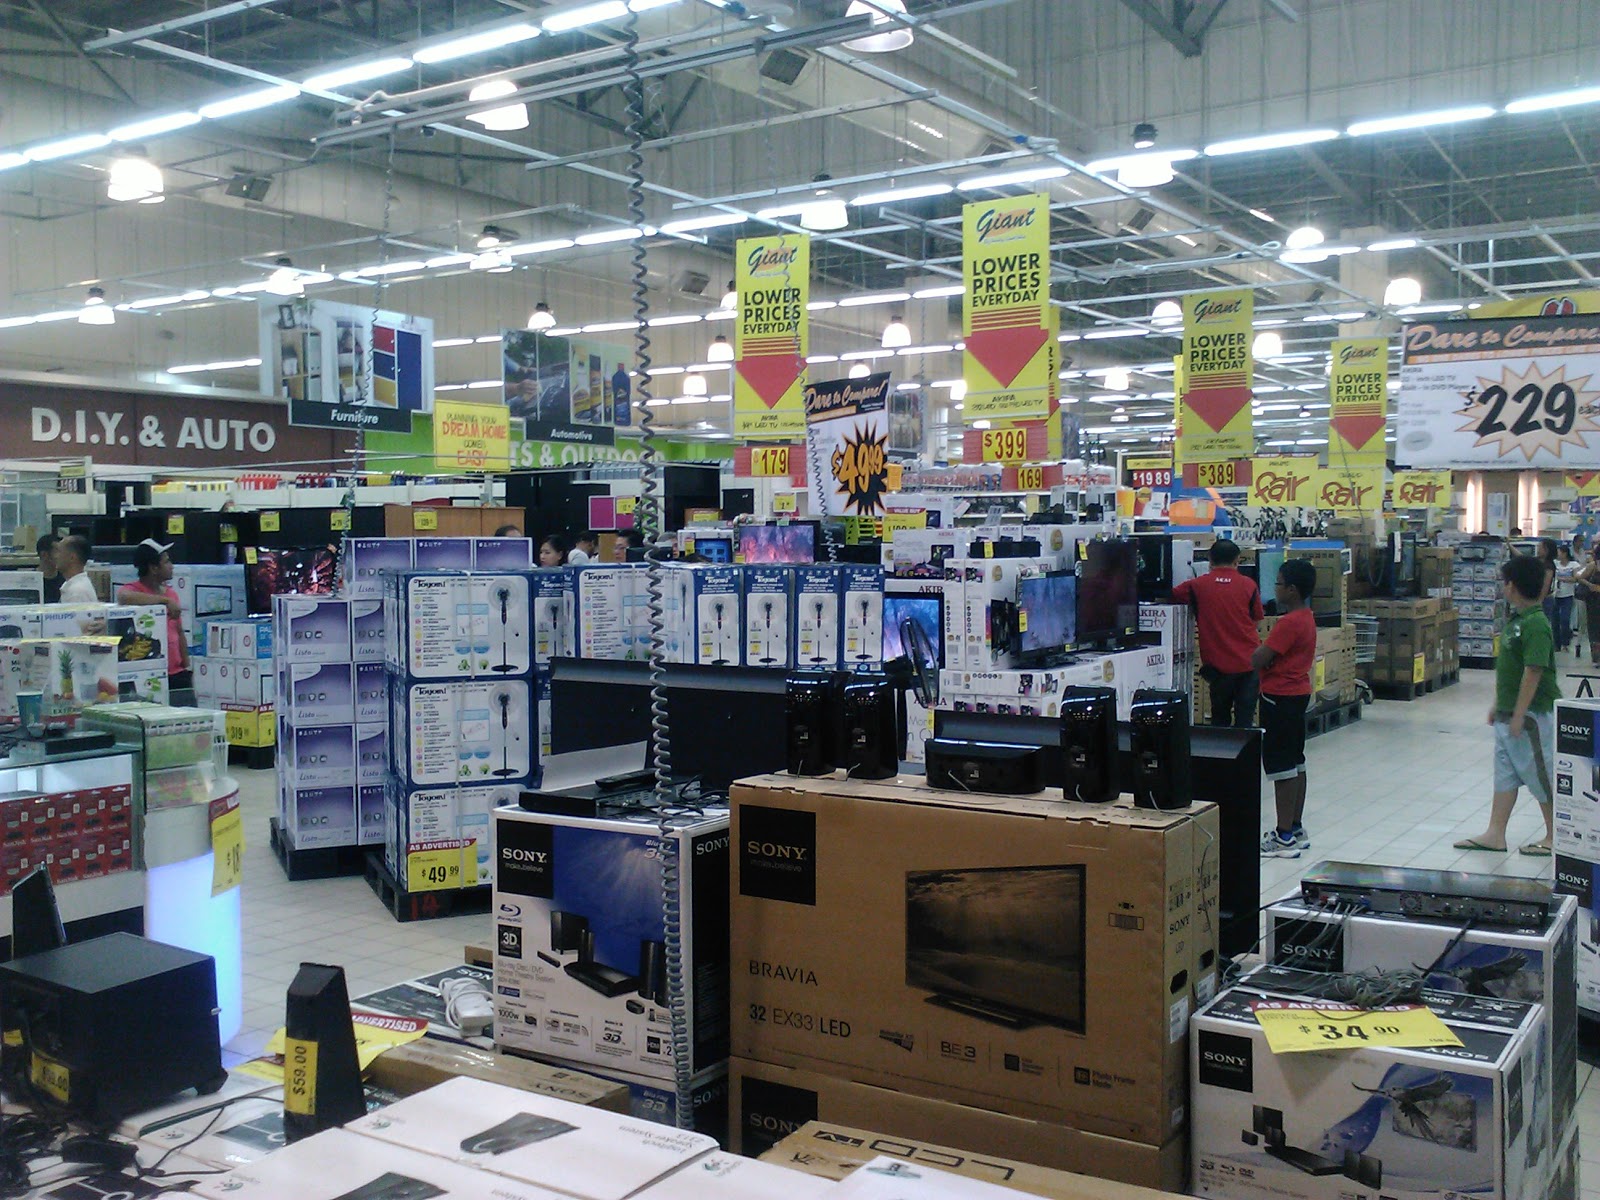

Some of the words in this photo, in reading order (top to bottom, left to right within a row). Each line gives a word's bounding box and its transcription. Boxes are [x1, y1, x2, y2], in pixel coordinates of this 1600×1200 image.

[976, 207, 1036, 242] Giant
[748, 245, 799, 277] Giant
[973, 253, 1040, 277] LOWER
[973, 271, 1040, 295] PRICES
[744, 287, 801, 306] LOWER
[972, 289, 1040, 308] EVERYDAY
[744, 304, 801, 323] PRICES
[1193, 299, 1242, 324] Giant
[743, 320, 800, 335] EVERYDAY
[1190, 332, 1246, 350] LOWER
[1406, 324, 1478, 351] Dare
[1480, 329, 1499, 345] to
[1190, 346, 1246, 363] PRICES
[1340, 345, 1379, 365] Giant
[1190, 359, 1245, 373] EVERYDAY
[1336, 372, 1382, 385] LOWER
[1336, 383, 1382, 395] PRICES
[804, 387, 832, 413] Dare
[833, 391, 843, 404] to
[1336, 393, 1380, 403] EVERYDAY
[330, 409, 380, 425] Furniture
[31, 406, 130, 447] D.I.Y.
[138, 415, 167, 448] &
[176, 417, 277, 453] AUTO
[442, 420, 480, 438] DREAM
[483, 424, 507, 440] HOME
[550, 428, 594, 442] Automotive
[457, 450, 489, 467] EASY
[539, 440, 555, 467] &
[1019, 467, 1043, 490] 169
[919, 585, 944, 594] AKIR
[1140, 609, 1167, 618] KIRA
[1146, 652, 1166, 667] AKIRA
[1560, 724, 1590, 736] SONY
[409, 843, 421, 851] AS
[422, 840, 471, 850] ADVERTISD
[696, 837, 730, 856] SONY
[748, 840, 808, 861] SONY
[502, 847, 547, 863] SONY
[428, 865, 447, 883] 49
[1558, 872, 1589, 887] SONY
[1169, 914, 1191, 935] SONY
[502, 931, 518, 946] 3D
[1281, 943, 1337, 960] SONY
[750, 959, 819, 987] BRAVIA
[1256, 1001, 1282, 1009] AS
[749, 1003, 766, 1023] 32
[773, 1008, 814, 1031] EX33
[820, 1017, 851, 1038] LED
[1317, 1024, 1370, 1041] 34
[1203, 1050, 1248, 1067] SONY
[1426, 1046, 1490, 1060] SONY
[292, 1045, 308, 1096] $59.00
[641, 1098, 667, 1113] 3D
